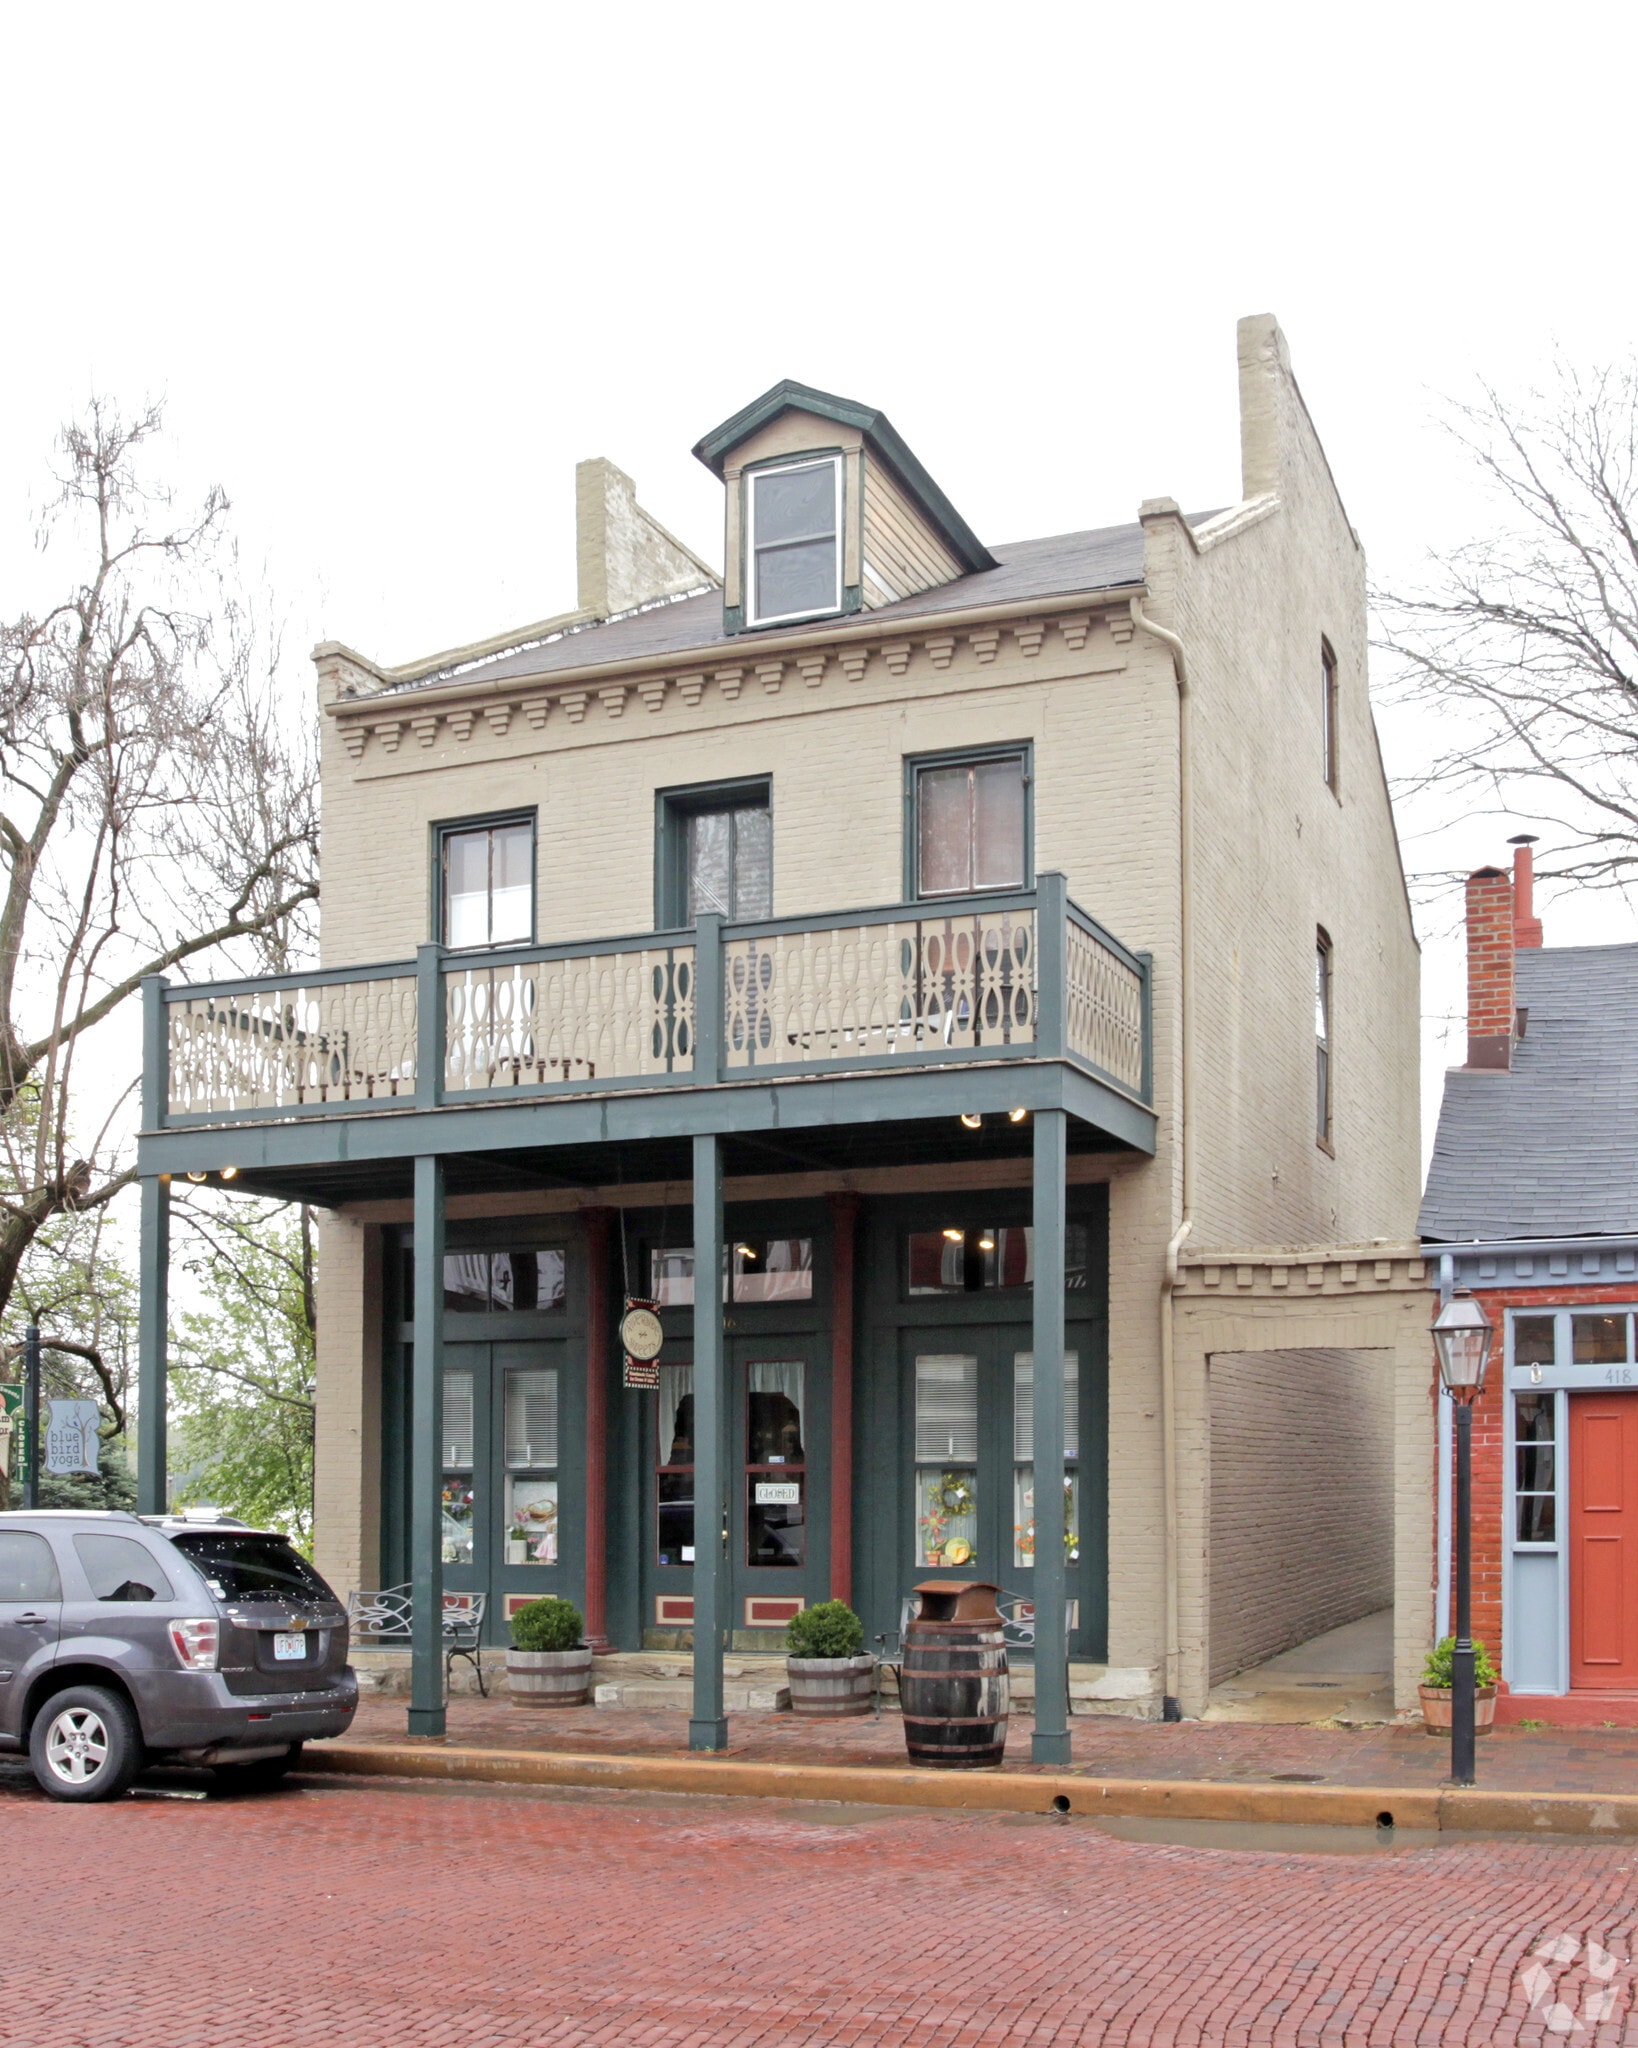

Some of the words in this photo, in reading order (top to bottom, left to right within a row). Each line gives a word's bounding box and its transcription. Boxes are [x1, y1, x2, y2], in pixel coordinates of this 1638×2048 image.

[1604, 1368, 1632, 1384] 418
[18, 1420, 26, 1462] CLOSED
[51, 1430, 79, 1442] blue
[51, 1443, 80, 1455] bird
[51, 1456, 80, 1468] yoga
[759, 1488, 795, 1499] CLOSED
